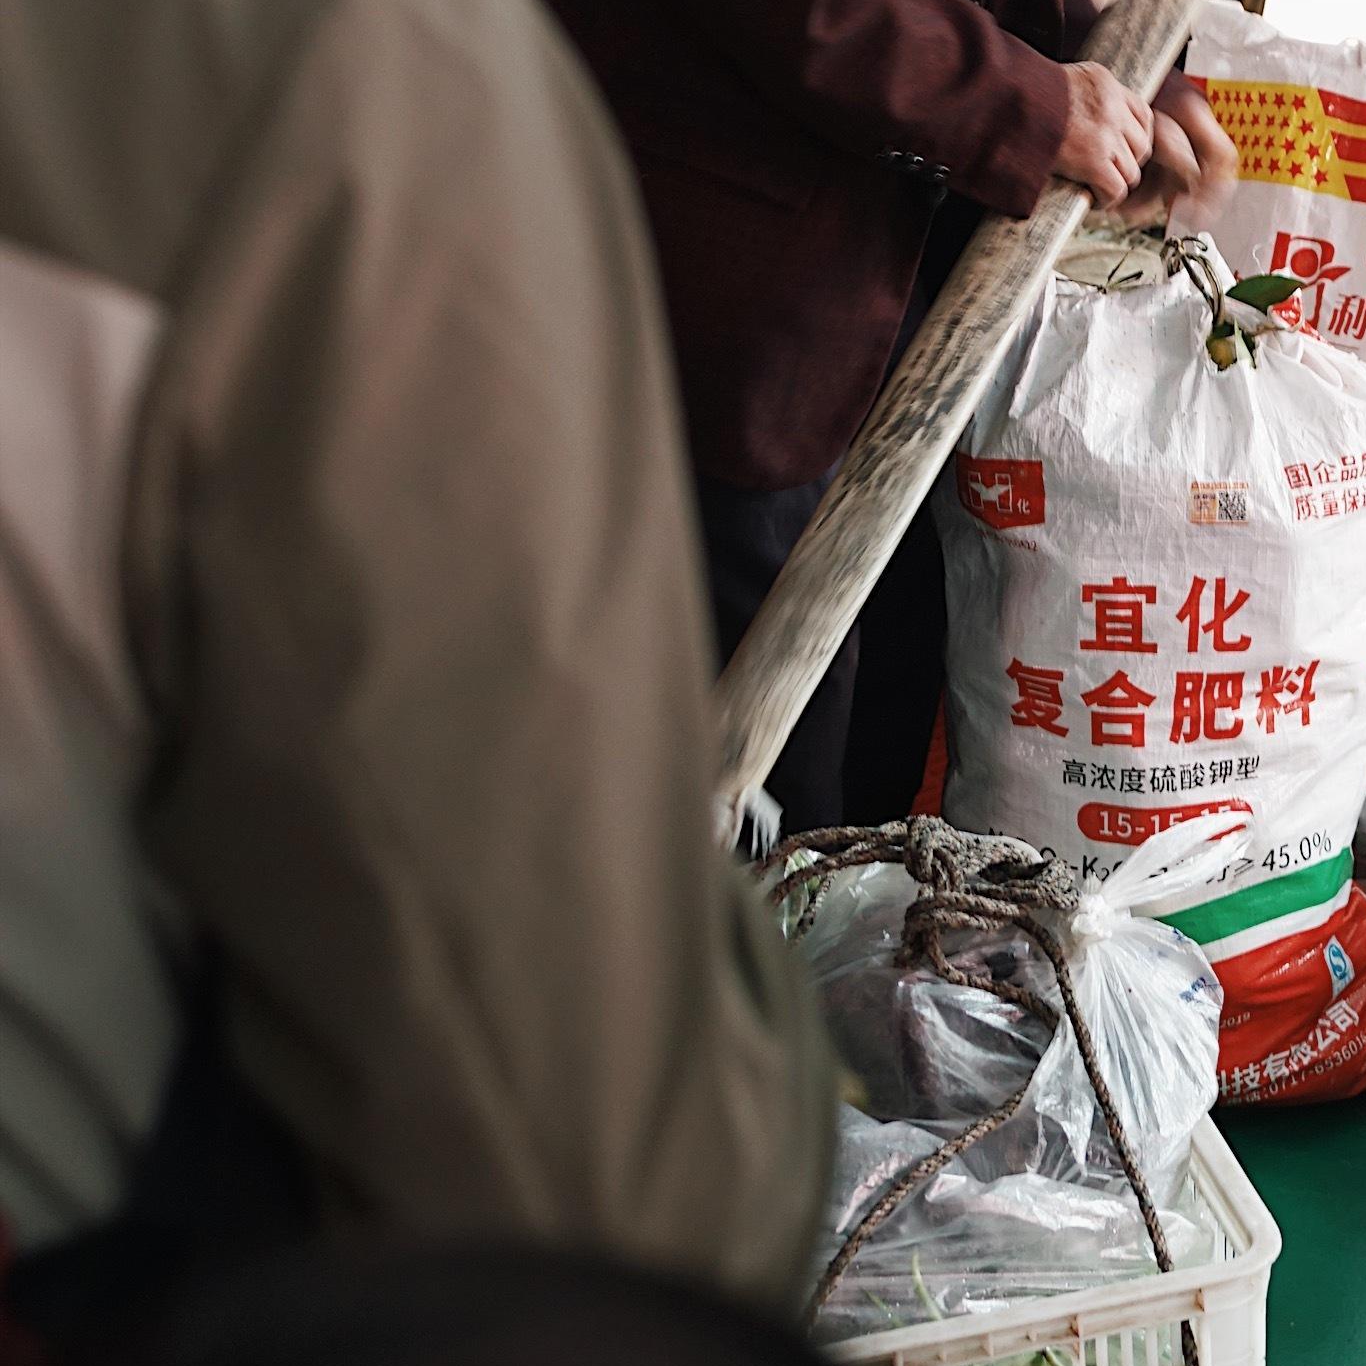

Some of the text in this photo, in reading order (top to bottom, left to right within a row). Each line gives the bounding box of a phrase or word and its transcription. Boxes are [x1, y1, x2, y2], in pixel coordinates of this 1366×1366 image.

[1080, 575, 1252, 653] 宜化
[1005, 657, 1321, 748] 复合肥料
[1061, 755, 1261, 794] 高浓度硫酸钾型
